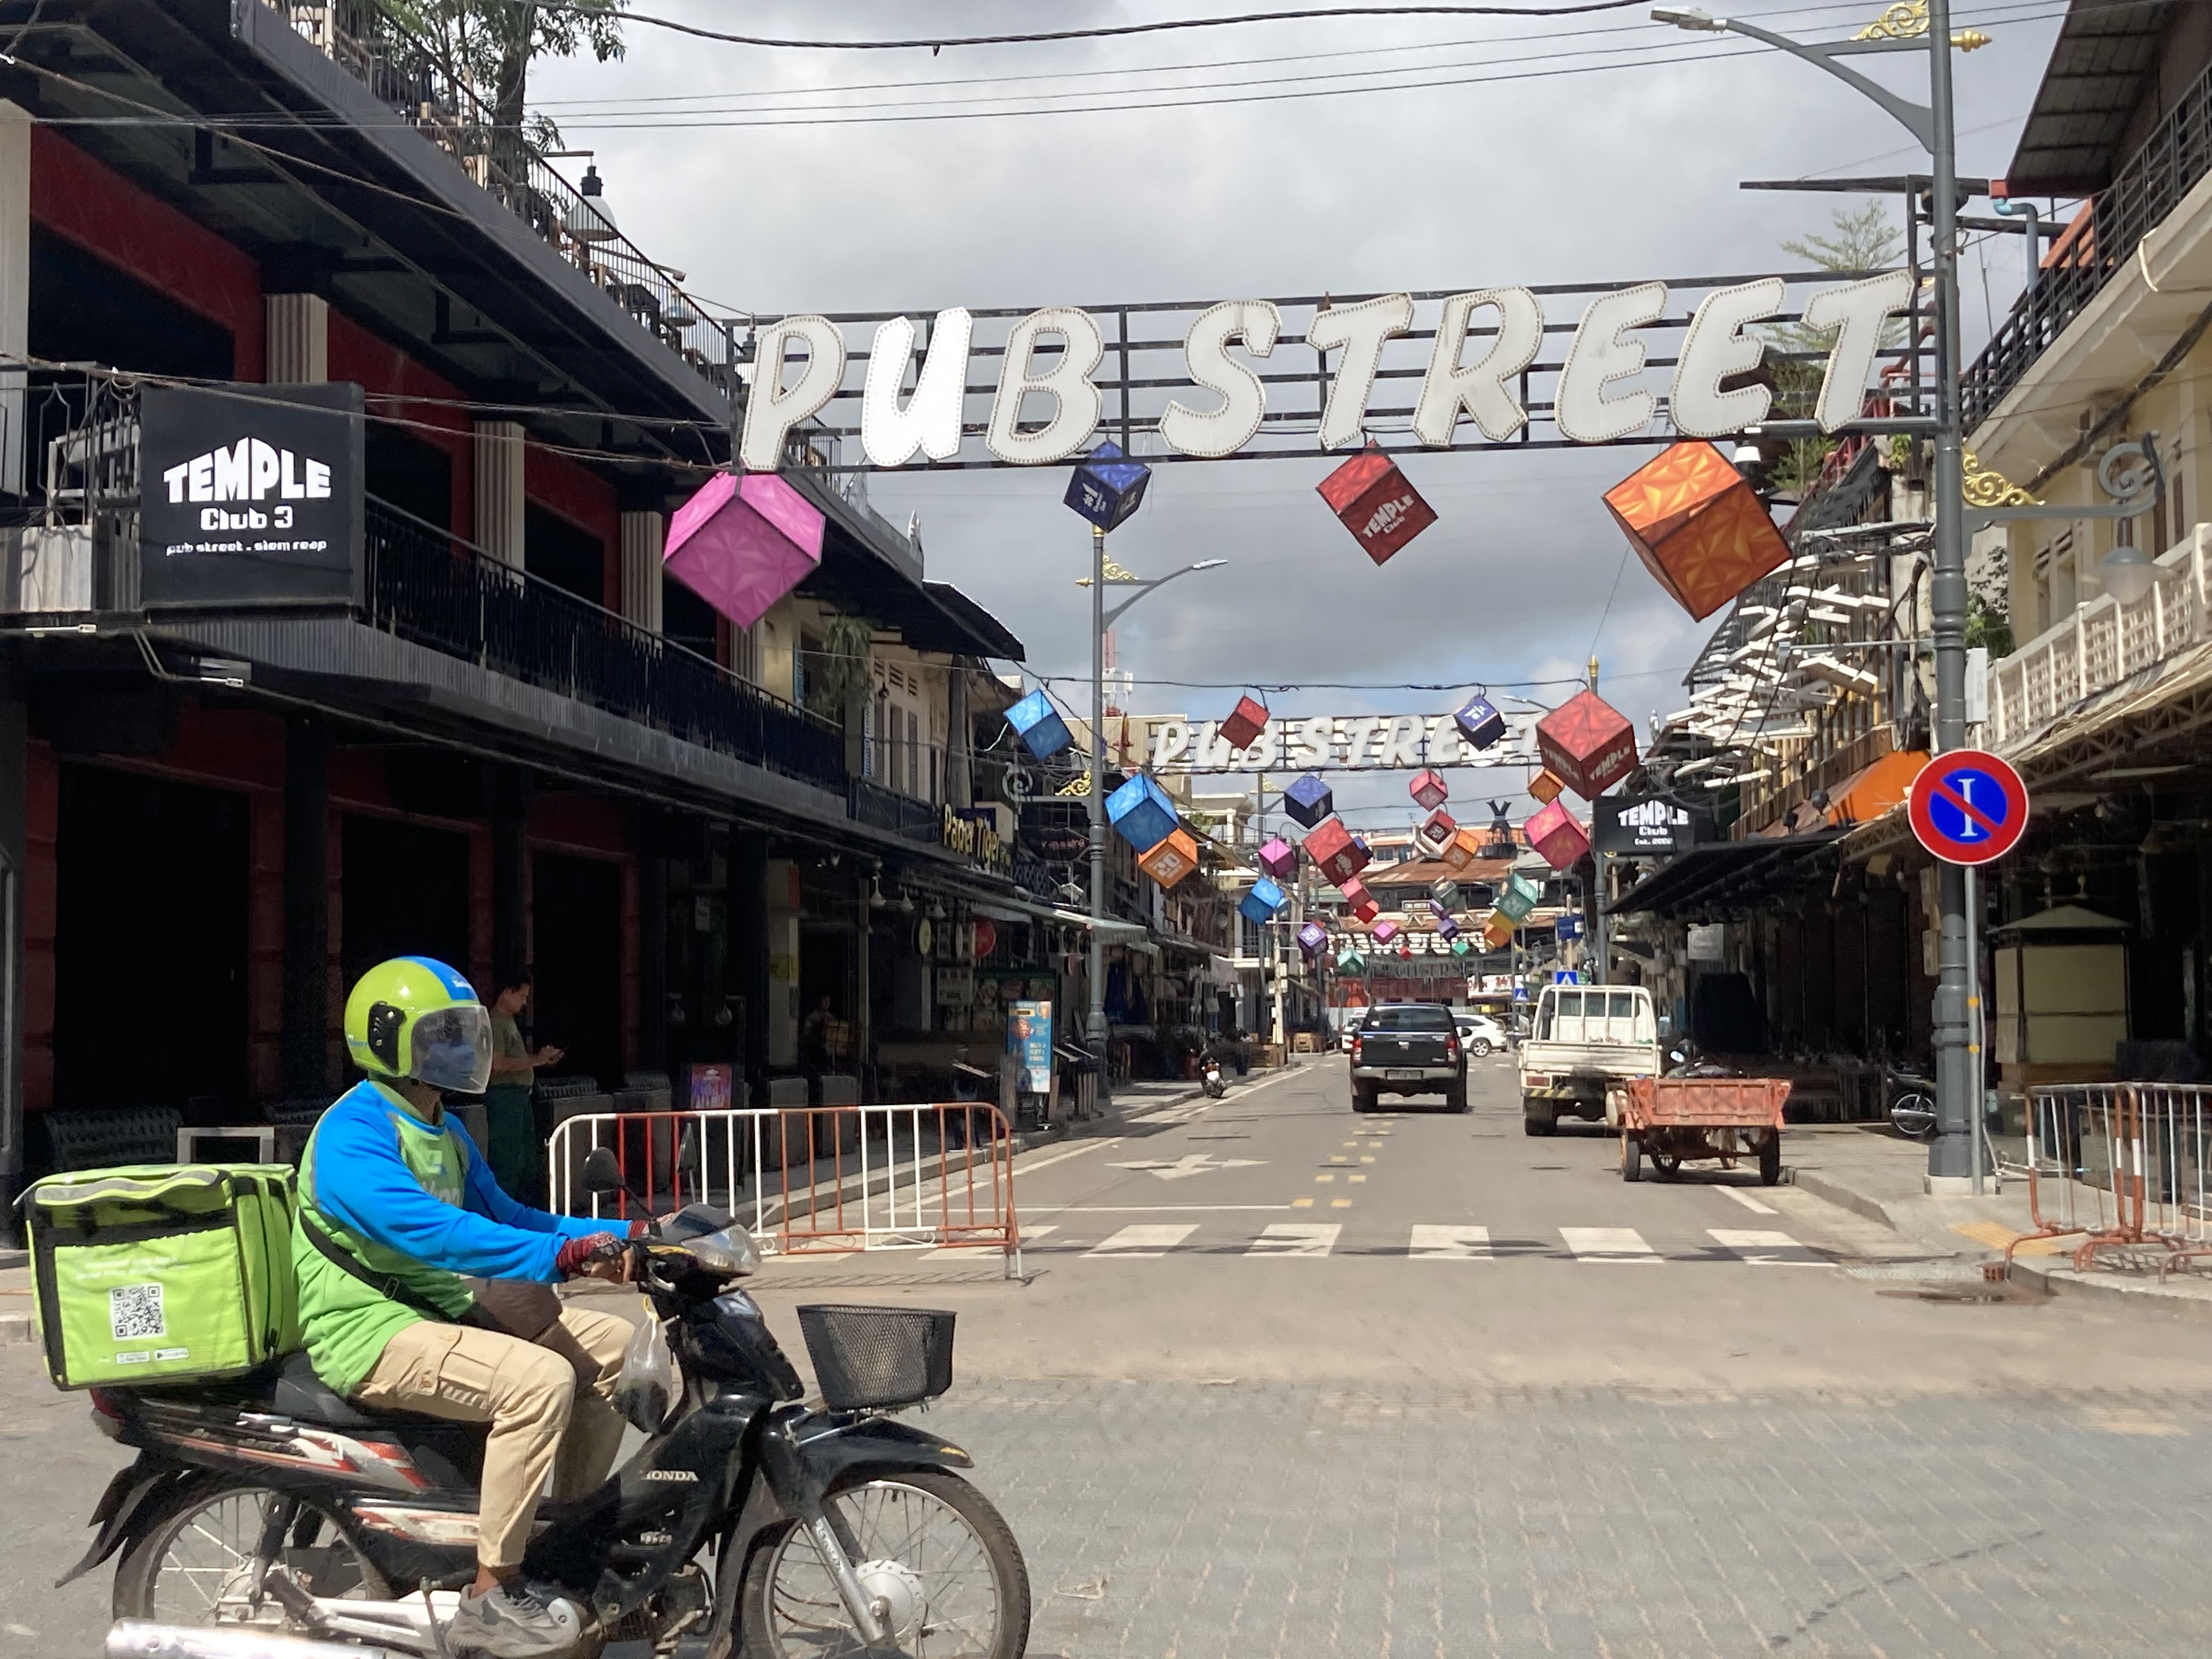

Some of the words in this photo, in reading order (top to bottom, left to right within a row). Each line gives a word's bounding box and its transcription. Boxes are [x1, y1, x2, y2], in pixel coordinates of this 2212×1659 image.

[741, 305, 1103, 470] PUB
[1159, 269, 1915, 458] STREET
[164, 437, 330, 503] TEMPLE
[201, 508, 267, 530] Club
[274, 506, 294, 528] 3
[1362, 494, 1414, 538] TEMPLE
[166, 541, 193, 556] pub
[196, 540, 243, 552] street
[254, 540, 290, 552] siem
[1152, 720, 1278, 772] PUB
[1618, 799, 1689, 826] TEMPLE
[1639, 826, 1668, 836] Club
